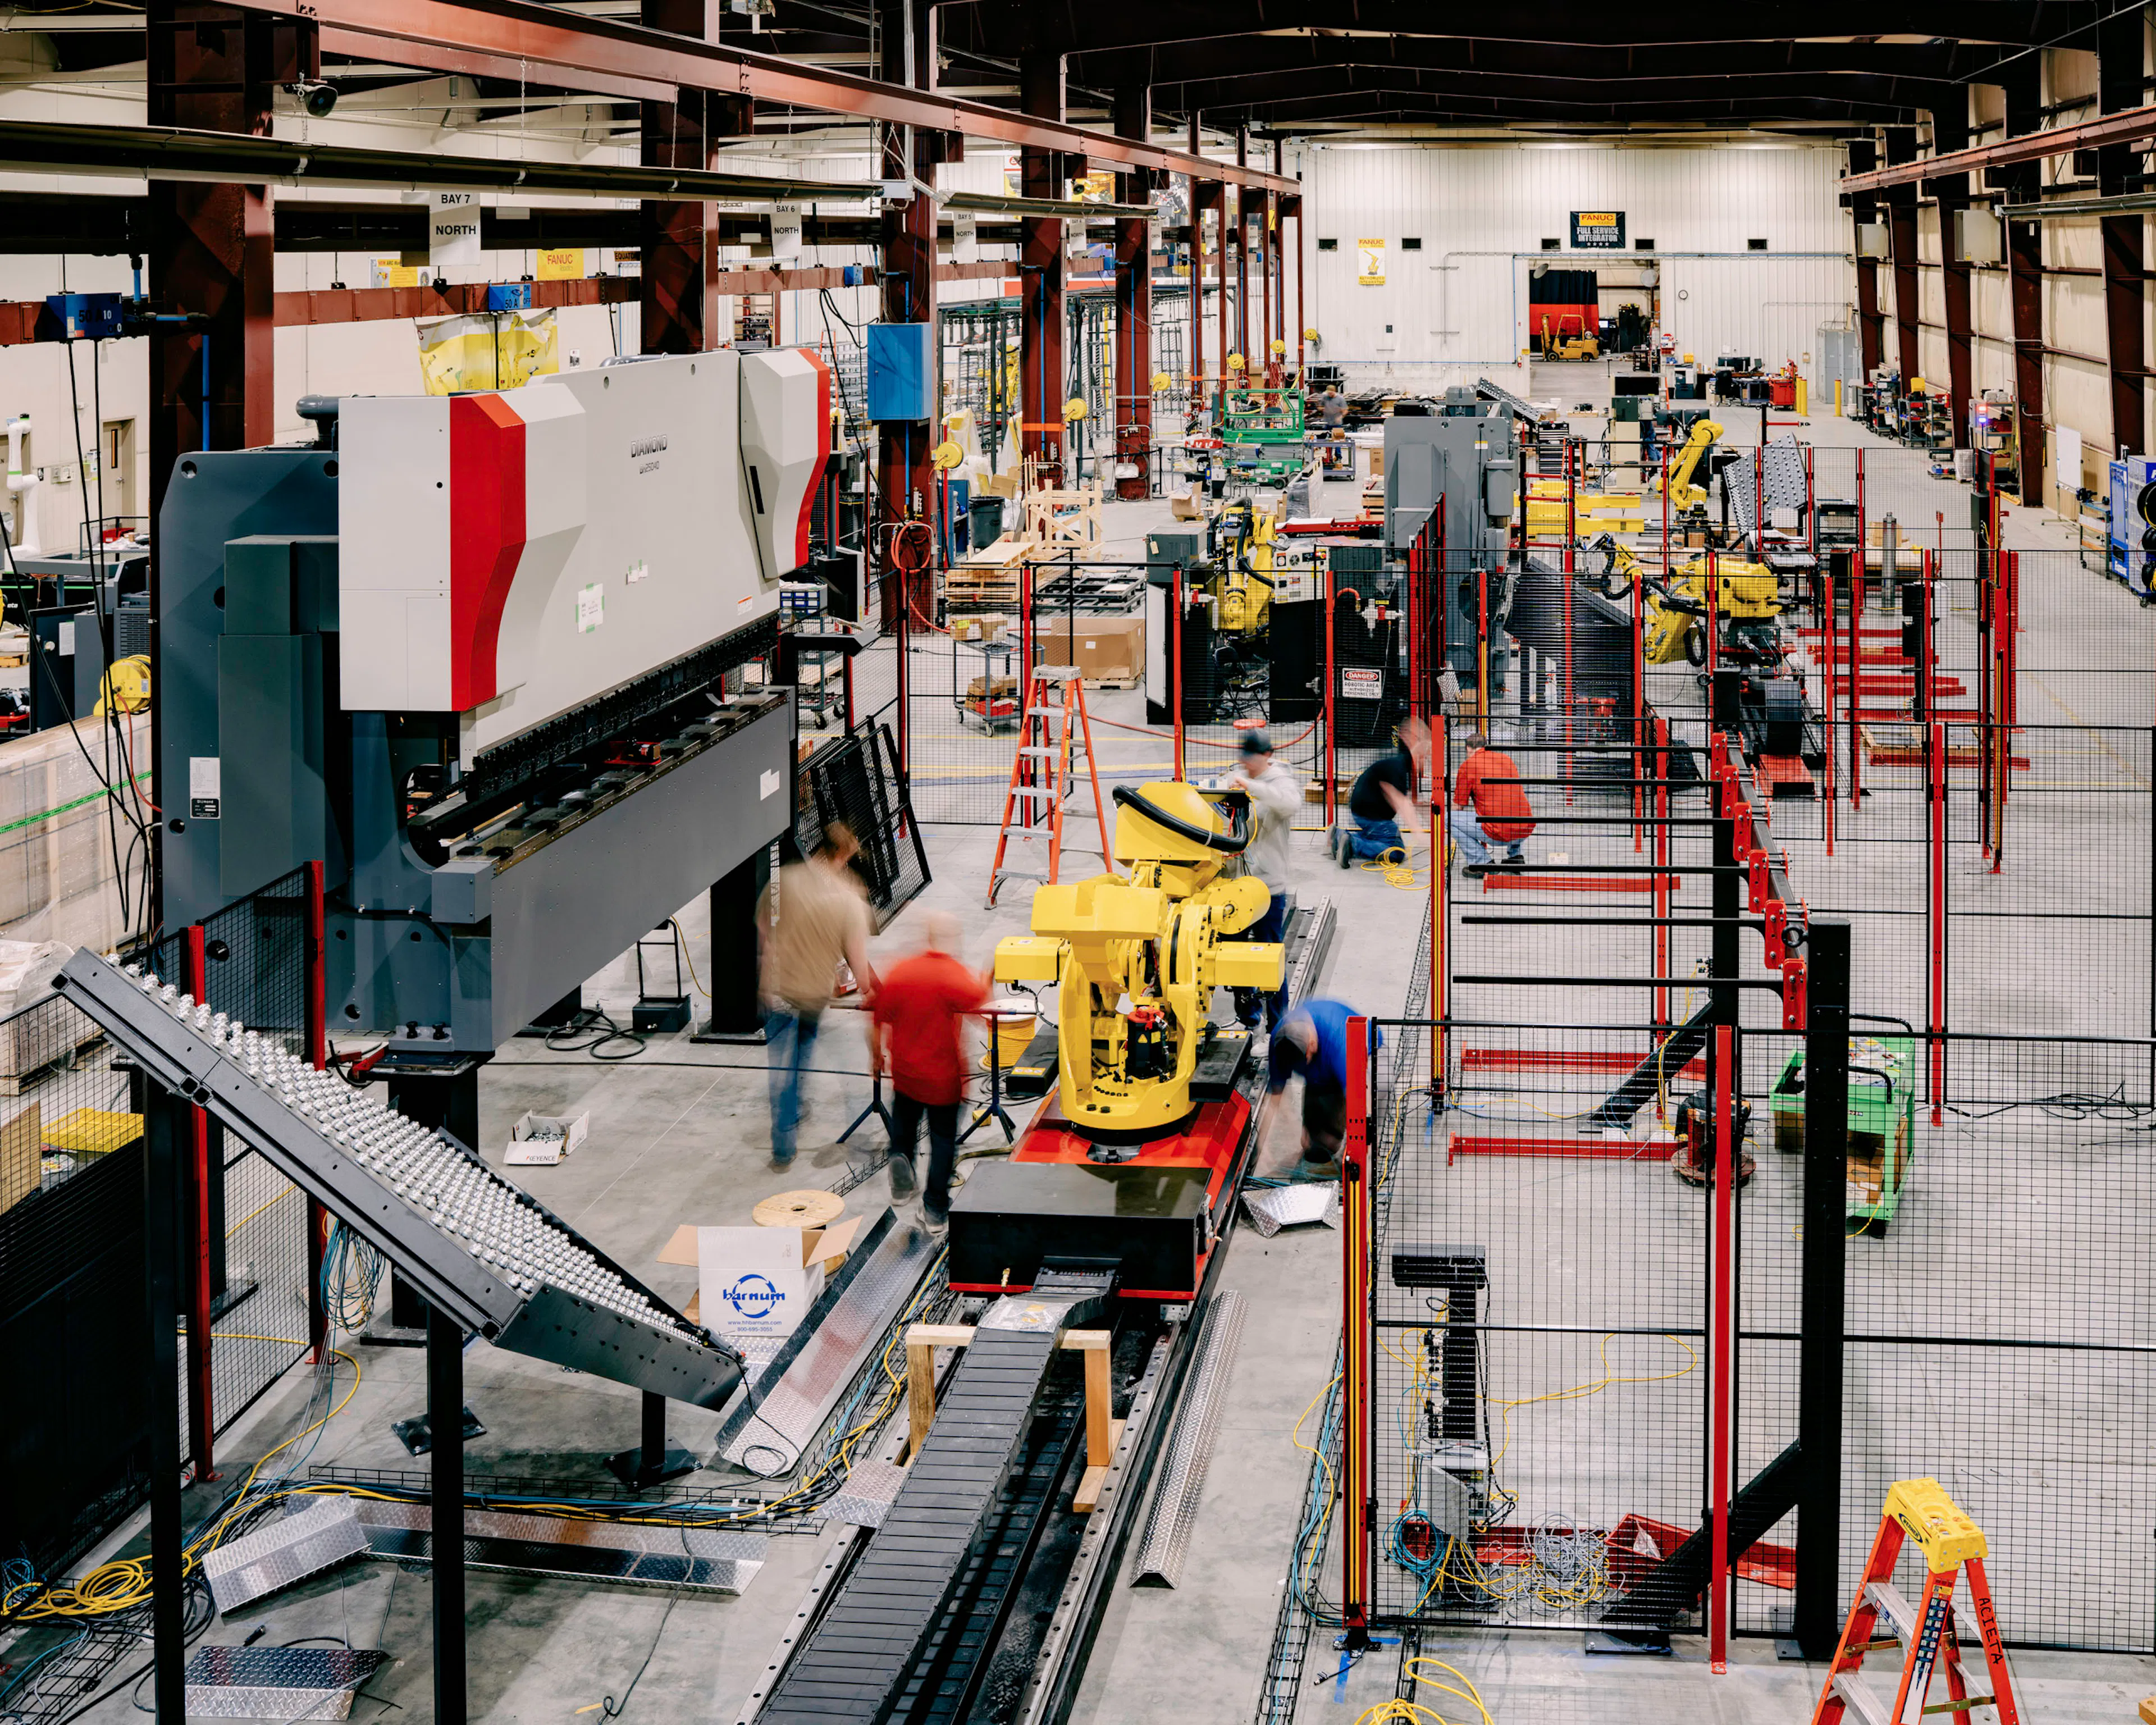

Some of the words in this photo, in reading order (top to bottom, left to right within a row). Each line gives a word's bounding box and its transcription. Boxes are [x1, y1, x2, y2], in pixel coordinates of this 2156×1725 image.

[441, 194, 462, 204] BAY
[464, 194, 471, 203] 7
[436, 225, 476, 235] NORTH
[547, 254, 573, 264] FANUC
[505, 299, 512, 308] 50
[513, 299, 518, 308] A
[79, 309, 92, 323] 50
[631, 434, 667, 458] DIAMOND
[723, 1289, 785, 1300] barnum
[1903, 1518, 1919, 1537] WERNER
[1979, 1598, 2004, 1665] ACIETA
